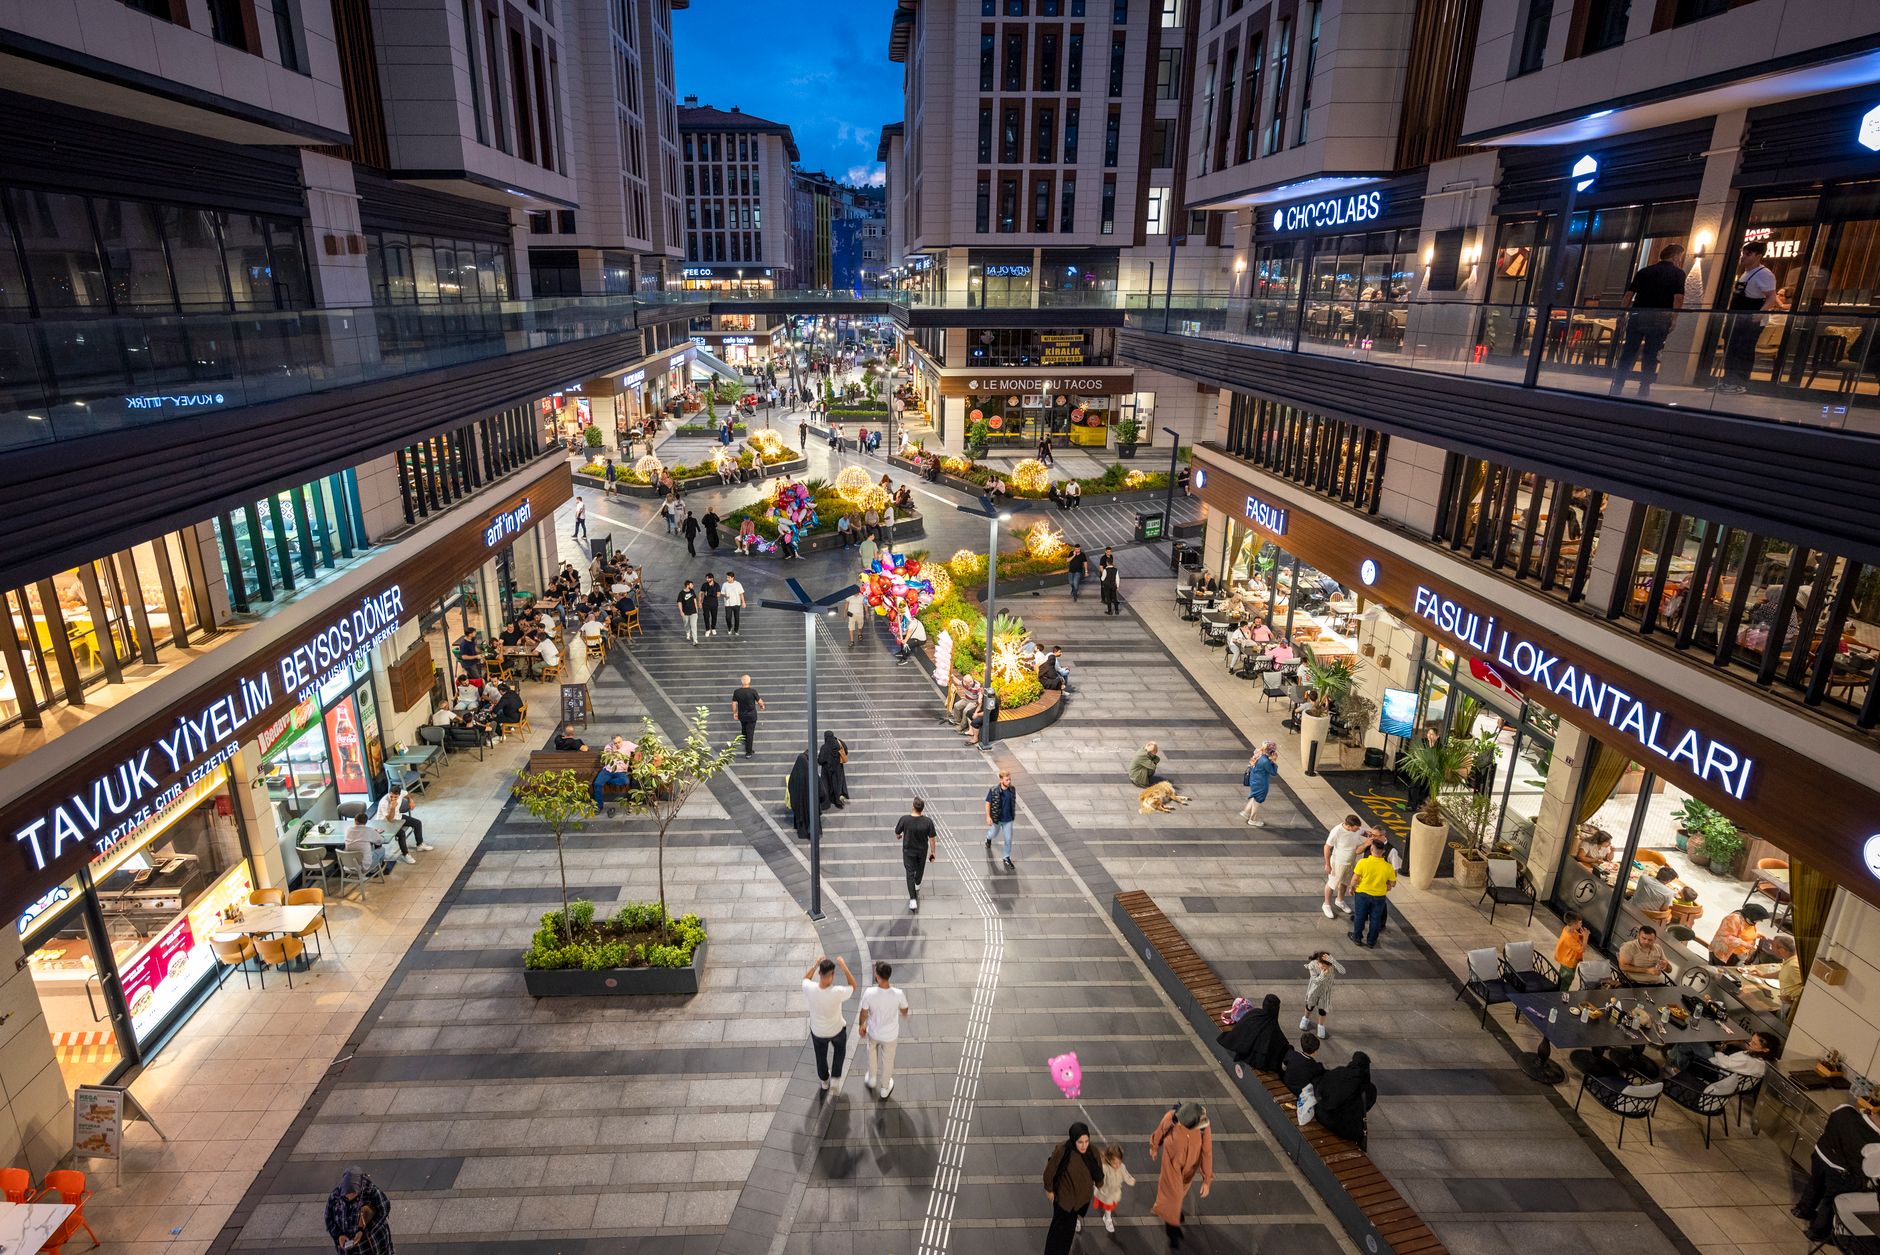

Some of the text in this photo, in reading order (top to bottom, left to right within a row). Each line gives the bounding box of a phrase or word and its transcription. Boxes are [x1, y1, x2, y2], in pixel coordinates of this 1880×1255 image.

[1286, 191, 1381, 231] CHOCOLABS
[1763, 240, 1801, 259] ATE!
[699, 268, 713, 276] CO.
[722, 336, 736, 344] cafe
[983, 380, 997, 390] LE
[1000, 380, 1042, 390] MONDE
[1064, 379, 1103, 390] TACOS
[515, 497, 531, 532] yeri
[1245, 496, 1285, 536] FASULİ
[298, 675, 328, 703] HATAY
[371, 619, 401, 649] MERKEZ
[1413, 585, 1753, 800] FASULİ LOKANTALARI
[16, 584, 404, 871] TAVUK YİYELİM BEYSOS DÖNER
[96, 805, 152, 854] TAPTAZE
[155, 782, 184, 813] ÇITIR
[186, 740, 241, 787] LEZZETLER
